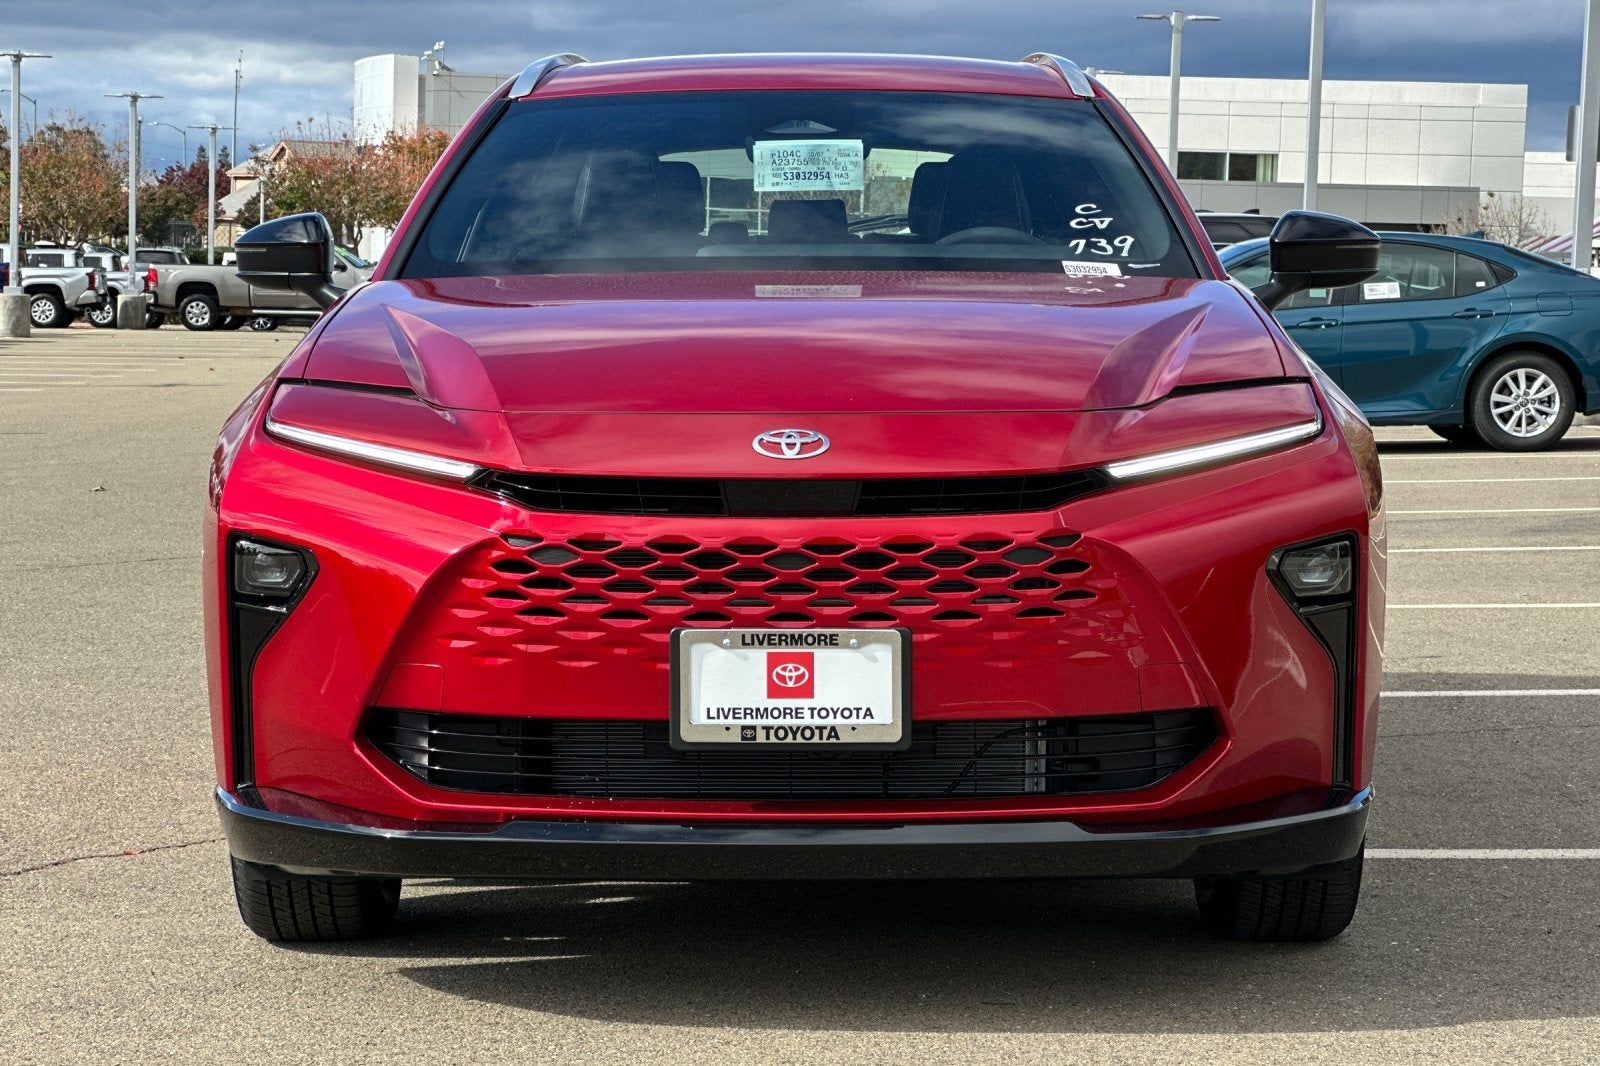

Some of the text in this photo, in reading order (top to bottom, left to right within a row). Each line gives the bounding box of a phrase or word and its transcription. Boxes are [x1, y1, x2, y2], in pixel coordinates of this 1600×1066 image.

[771, 158, 808, 166] A23755
[783, 171, 831, 181] S3032954
[1074, 203, 1102, 215] C
[1064, 264, 1108, 274] S3032954
[741, 633, 839, 647] LIVERMORE
[706, 707, 874, 720] LIVERMORE TOYOTA
[762, 725, 841, 741] TOYOTA
